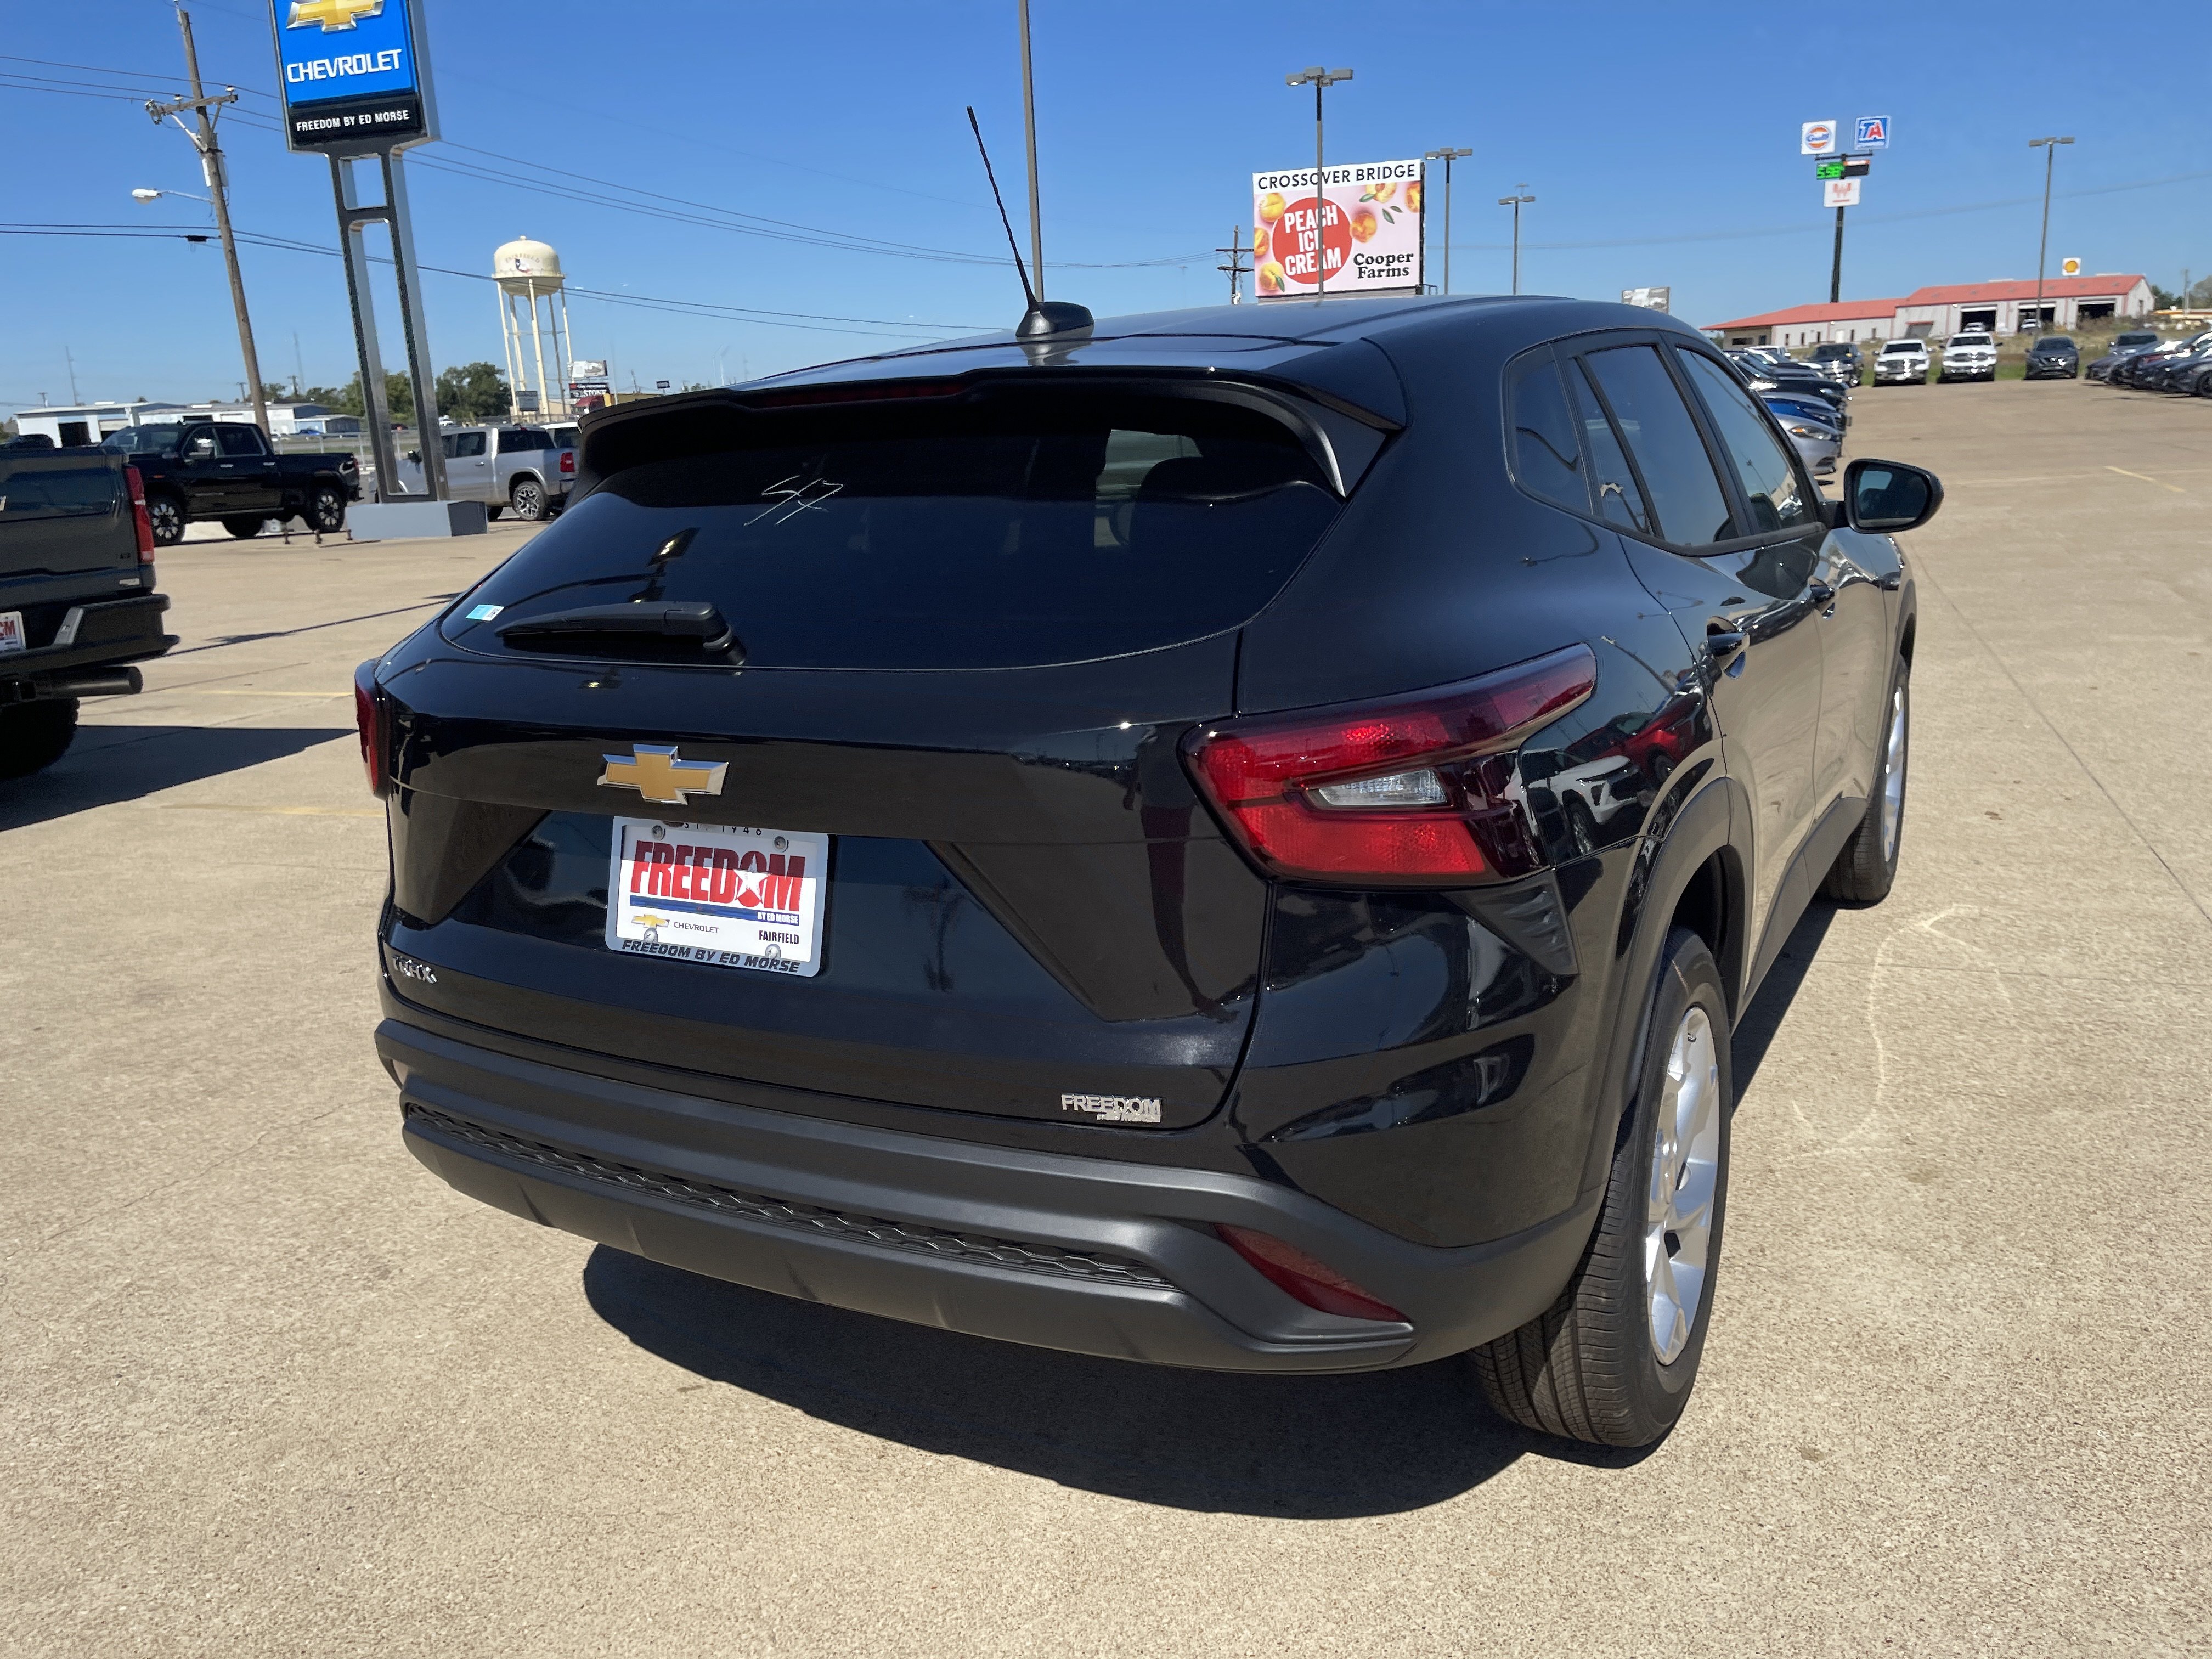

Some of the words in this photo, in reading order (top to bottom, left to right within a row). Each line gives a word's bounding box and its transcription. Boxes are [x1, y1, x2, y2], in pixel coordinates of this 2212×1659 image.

[287, 49, 402, 83] CHEVROLET
[296, 118, 341, 131] FREEDOM
[344, 116, 356, 126] BY
[358, 114, 372, 125] ED
[375, 110, 410, 123] MORSE
[1258, 170, 1351, 189] CROSSOVER
[1356, 164, 1415, 182] BRIDGE
[1353, 253, 1414, 267] Cooper
[1357, 266, 1409, 279] Farms
[630, 840, 806, 912] FREEDOM
[674, 922, 719, 933] CHEVROLET
[757, 911, 766, 921] BY
[766, 912, 775, 922] ED
[775, 913, 799, 924] MORSE
[759, 929, 800, 945] FAIRFIELD
[622, 939, 691, 958] FREEDOM
[694, 949, 716, 961] BY
[719, 952, 741, 965] ED
[744, 955, 801, 973] MORSE
[1061, 1094, 1161, 1116] FREEDOM
